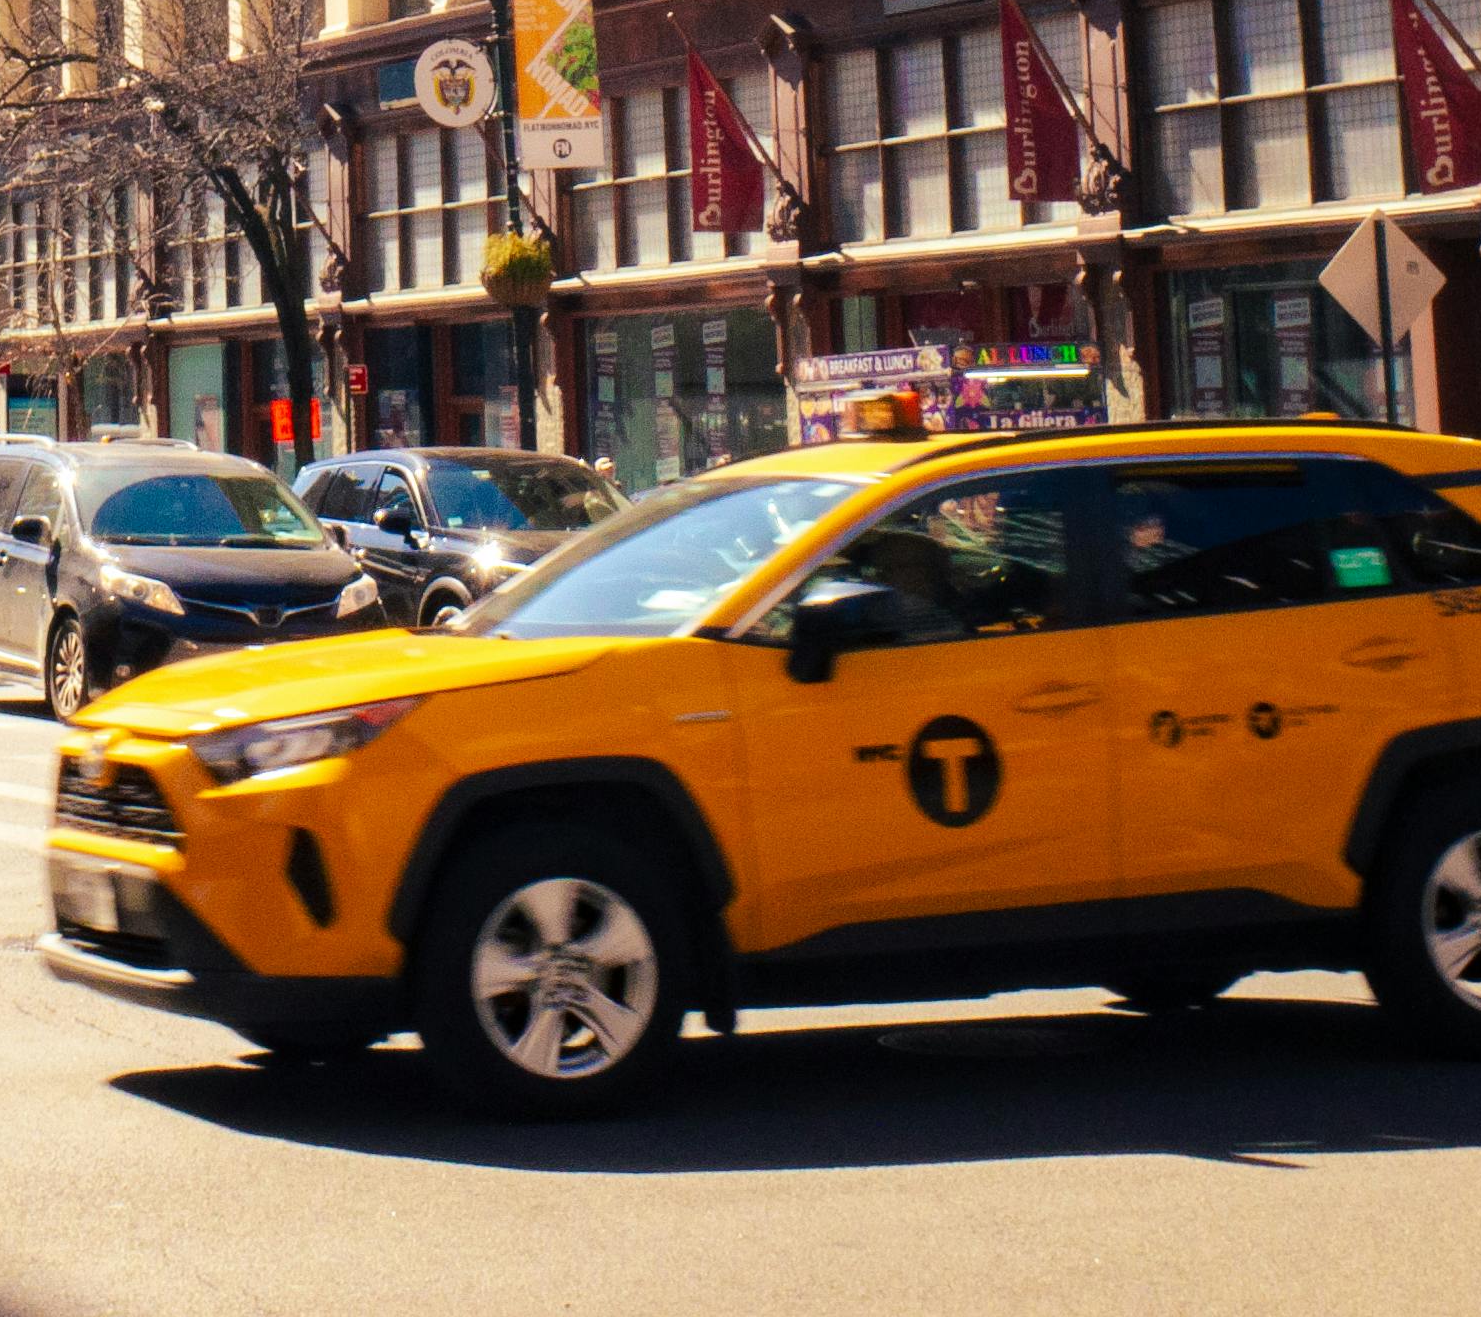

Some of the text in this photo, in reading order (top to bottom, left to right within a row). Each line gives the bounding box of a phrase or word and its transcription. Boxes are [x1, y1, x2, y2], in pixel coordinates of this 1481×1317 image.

[430, 47, 473, 62] COLOMBIA
[530, 60, 590, 118] NOMAD
[1014, 40, 1037, 195] Burlington
[698, 89, 725, 227] Burlington
[829, 356, 873, 375] BREAKFAST
[875, 358, 883, 372] &
[884, 353, 913, 370] LUNCH
[923, 737, 980, 814] T
